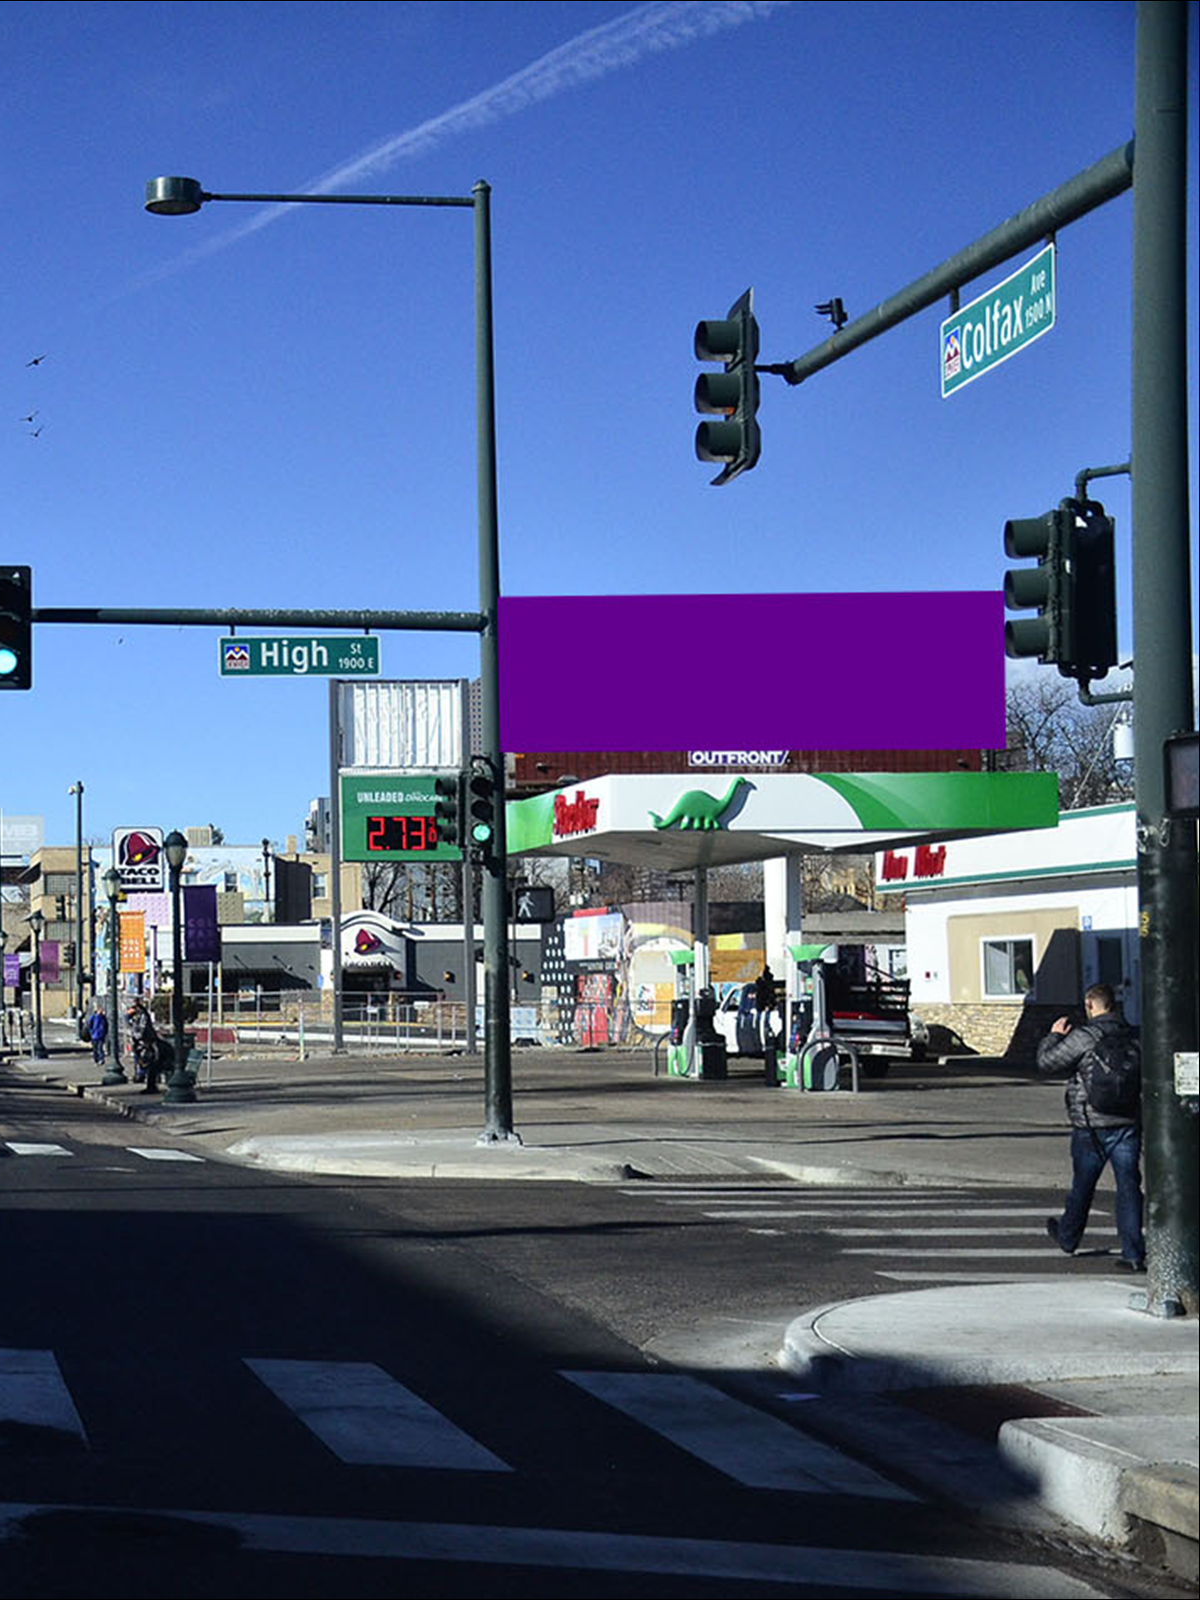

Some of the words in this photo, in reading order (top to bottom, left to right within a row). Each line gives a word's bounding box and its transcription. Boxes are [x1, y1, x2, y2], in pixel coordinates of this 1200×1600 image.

[1030, 270, 1046, 296] Ave
[1025, 297, 1044, 329] 1500
[962, 296, 1024, 370] Colfax
[350, 643, 362, 655] St
[260, 640, 328, 674] High
[338, 657, 365, 669] 1900
[367, 658, 375, 669] E
[356, 791, 404, 804] UNLEADED
[117, 867, 160, 876] TACO
[120, 877, 160, 885] BELL
